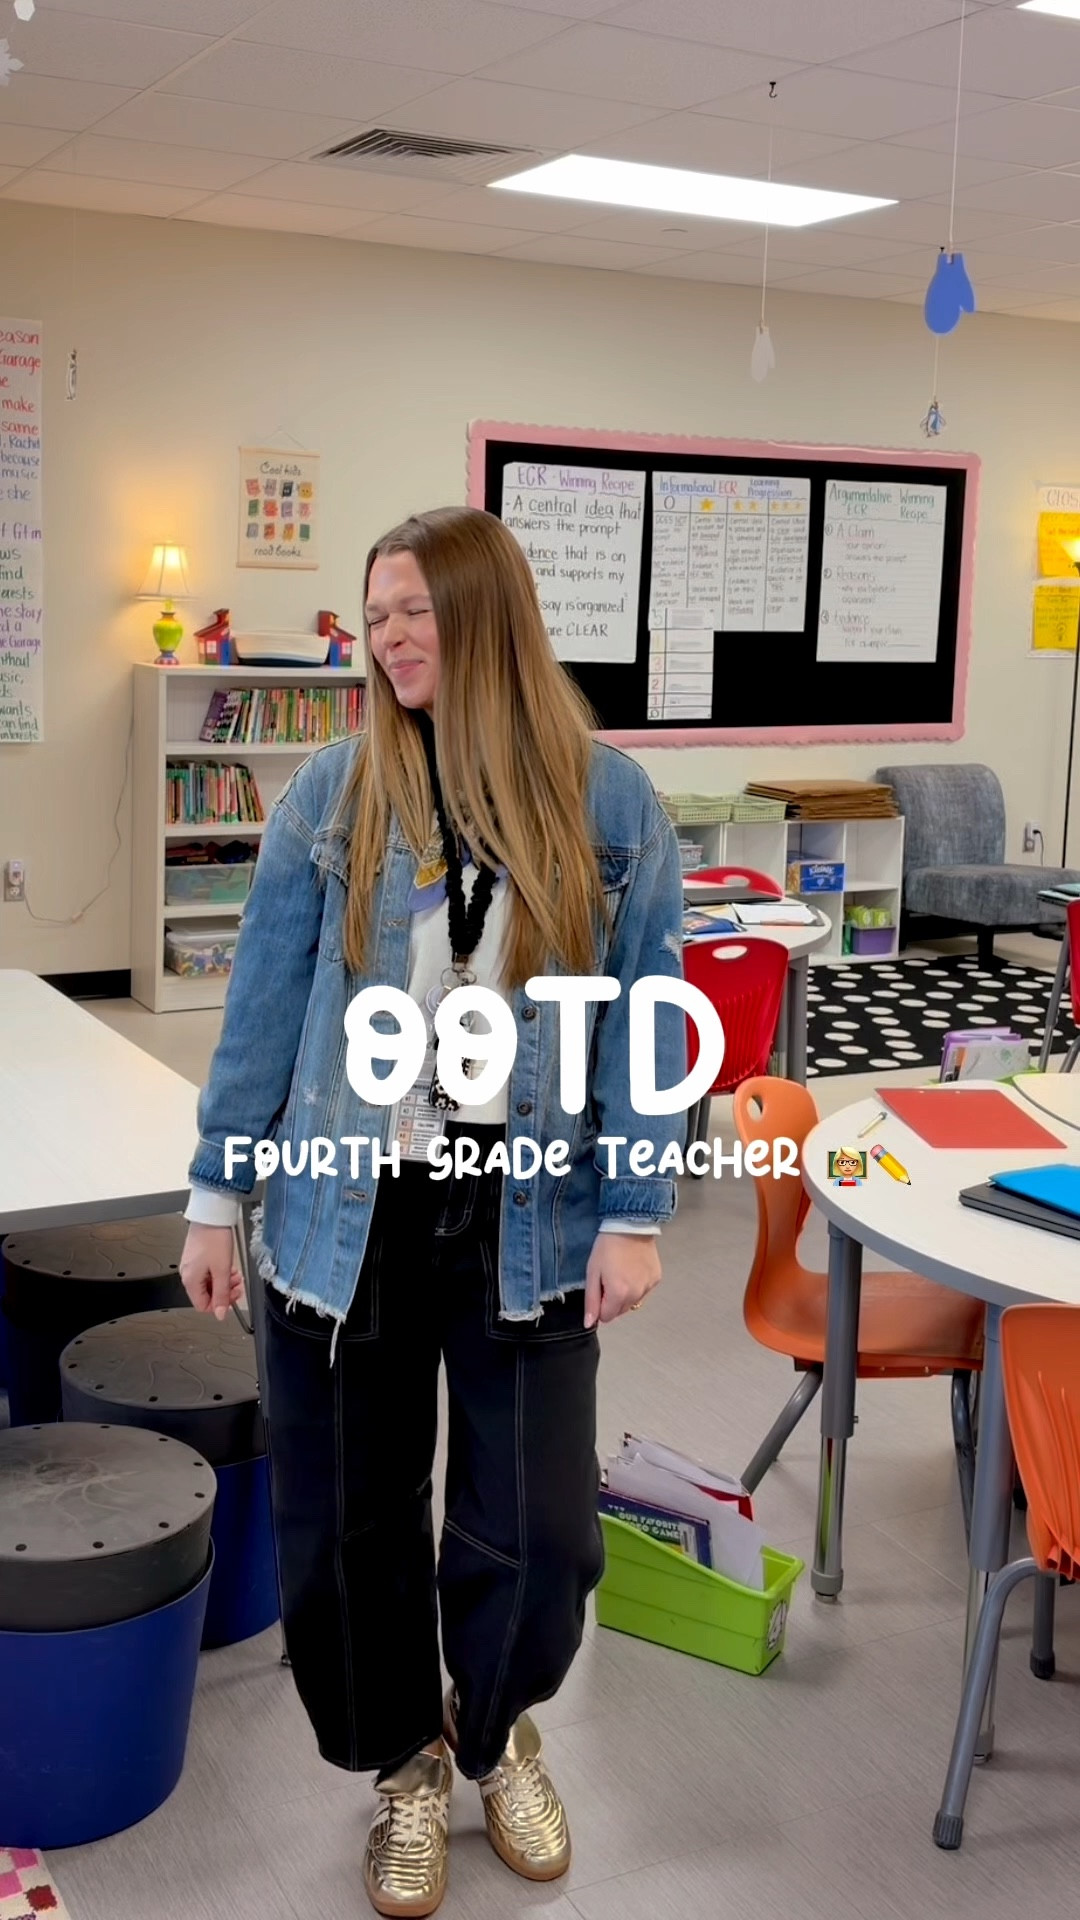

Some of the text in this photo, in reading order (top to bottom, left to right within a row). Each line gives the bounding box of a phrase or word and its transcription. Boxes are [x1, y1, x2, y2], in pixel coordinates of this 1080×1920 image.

[0, 330, 39, 345] eason
[2, 395, 35, 413] make
[1, 420, 38, 435] same
[1, 450, 40, 466] because
[2, 468, 38, 480] music
[517, 465, 547, 487] ECR
[560, 469, 597, 495] Winning
[602, 472, 634, 493] Recipe
[7, 484, 32, 501] she
[660, 475, 738, 496] Informational ECR
[528, 495, 577, 514] central
[585, 499, 614, 516] idea
[620, 501, 642, 520] that
[505, 516, 621, 538] answers the prompt
[565, 545, 588, 561] that
[595, 549, 606, 561] is
[611, 552, 626, 564] on
[535, 564, 625, 584] and supports my
[565, 600, 575, 611] is
[576, 597, 625, 617] organized
[566, 622, 608, 637] CLEAR
[651, 679, 659, 691] 2
[618, 1512, 681, 1531] OUR FAVORIT
[651, 1526, 681, 1539] GAME
